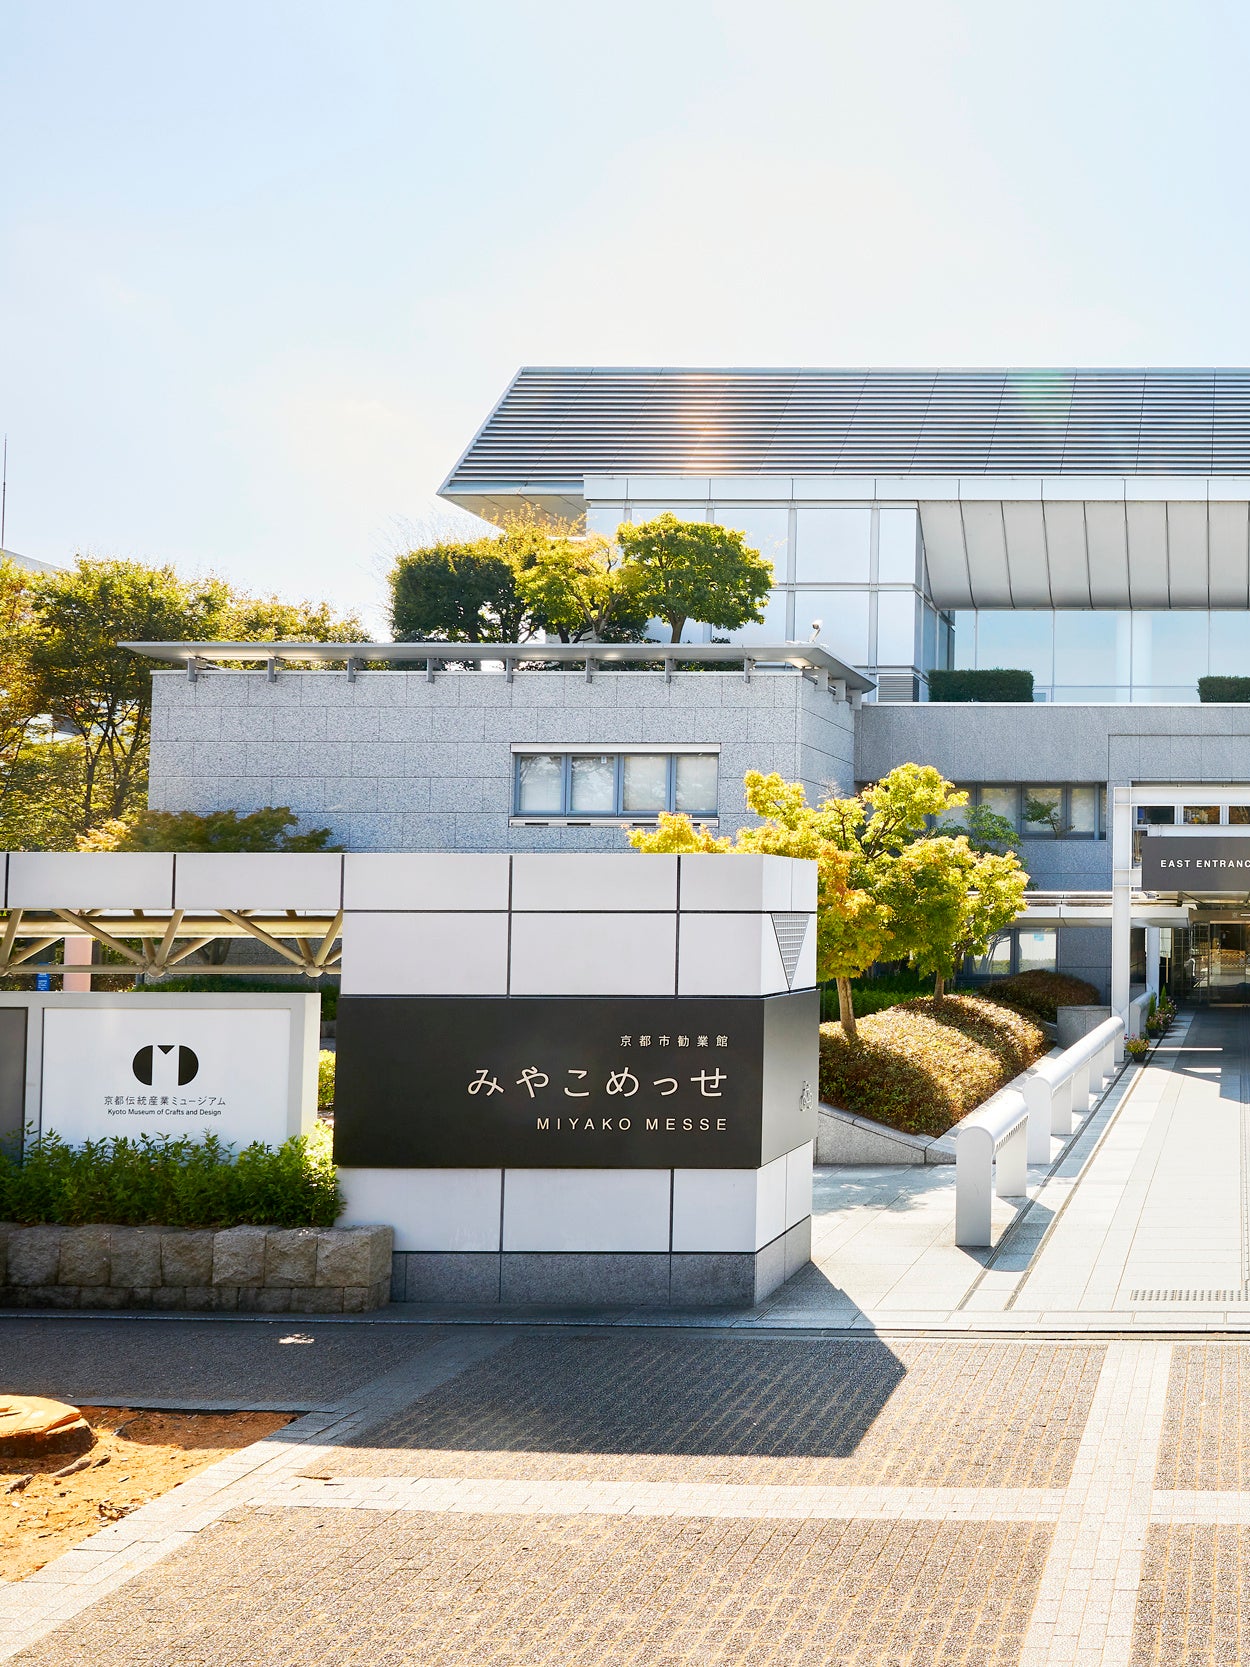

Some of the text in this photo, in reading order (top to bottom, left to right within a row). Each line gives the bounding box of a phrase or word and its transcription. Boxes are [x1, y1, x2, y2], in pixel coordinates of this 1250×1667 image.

[1160, 859, 1191, 868] EAST
[620, 1035, 729, 1048] 京都市勧業館
[467, 1066, 728, 1098] みやこめっせ
[104, 1096, 226, 1106] 京都伝統産業ミュージアム
[107, 1108, 127, 1116] Kyoto
[200, 1108, 222, 1116] Design
[536, 1118, 728, 1131] MIYAKO MESSE
